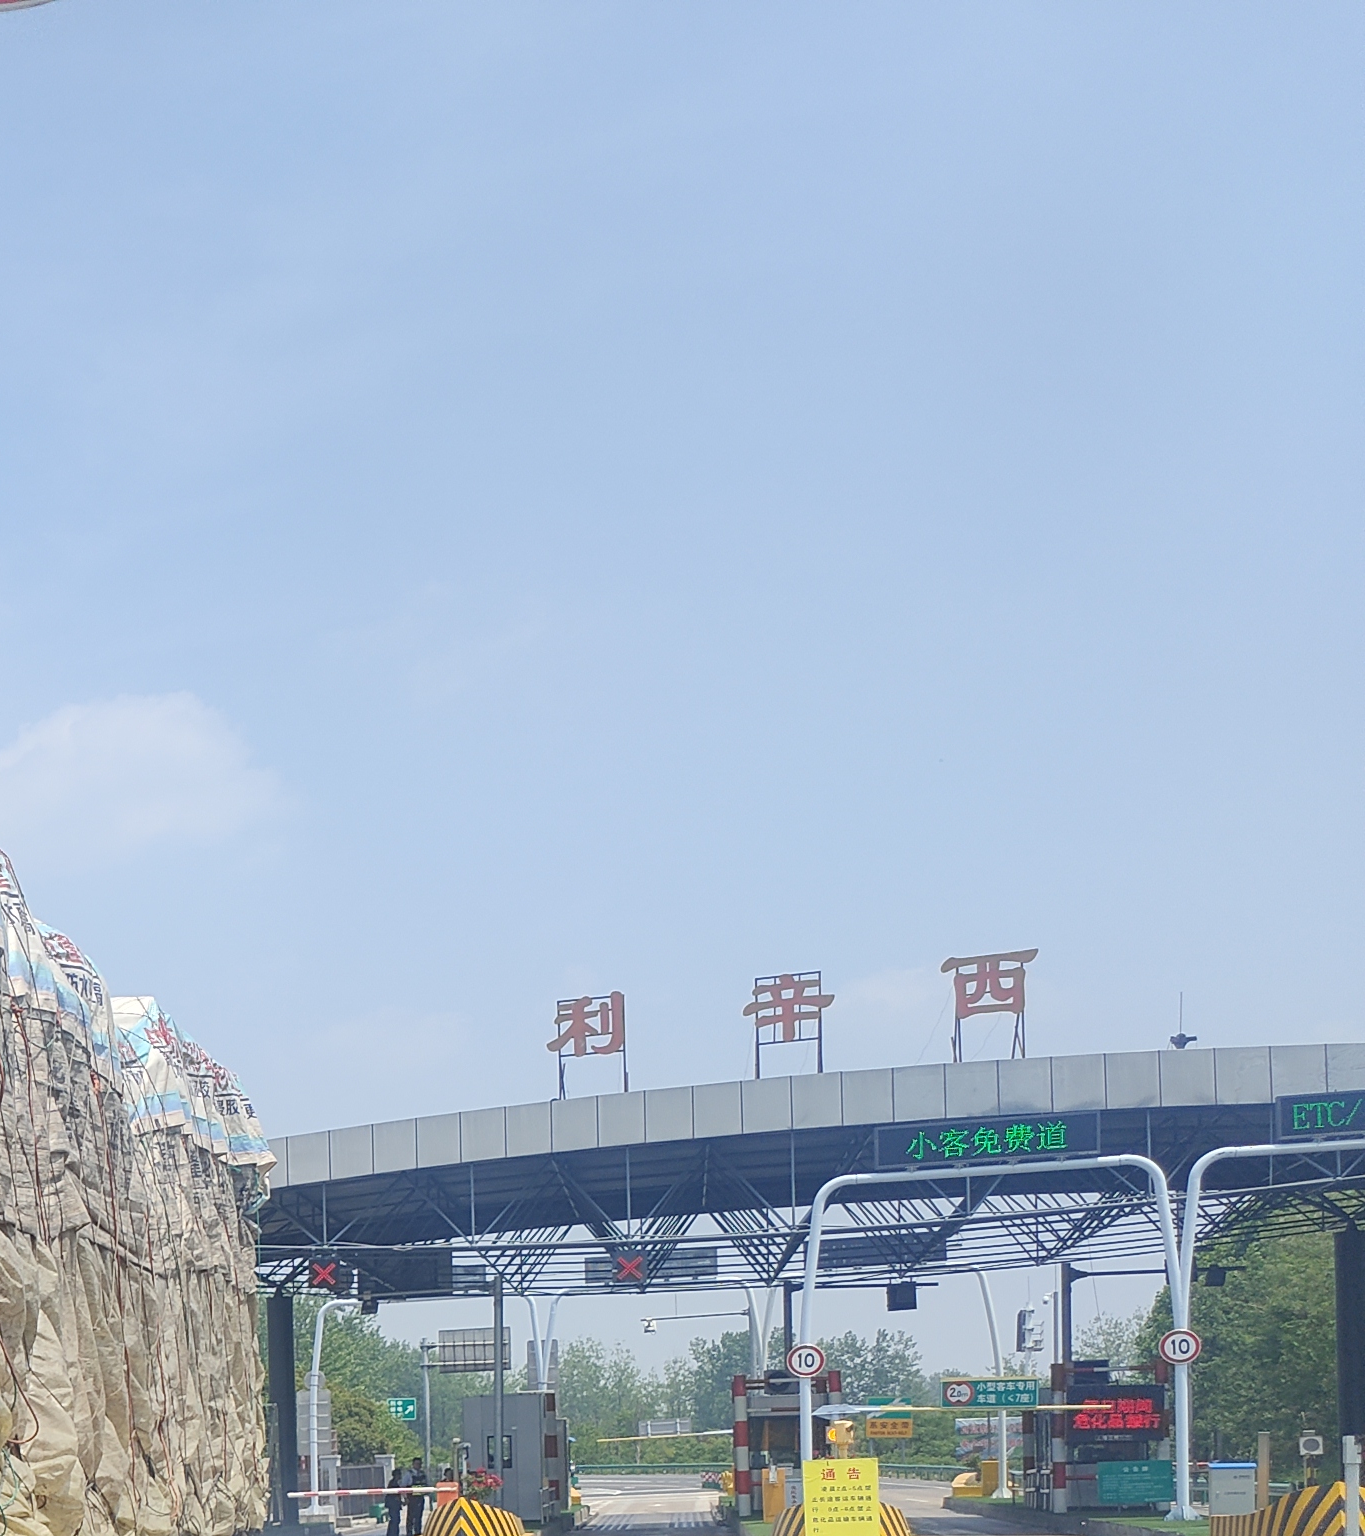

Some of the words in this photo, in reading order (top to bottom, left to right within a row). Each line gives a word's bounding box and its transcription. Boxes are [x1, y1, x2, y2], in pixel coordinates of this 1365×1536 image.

[906, 1120, 1068, 1160] 小客免费道
[1171, 1338, 1190, 1355] 10
[797, 1352, 815, 1368] 10
[976, 1381, 1035, 1391] 小型客车专用
[821, 1467, 861, 1480] 通告
